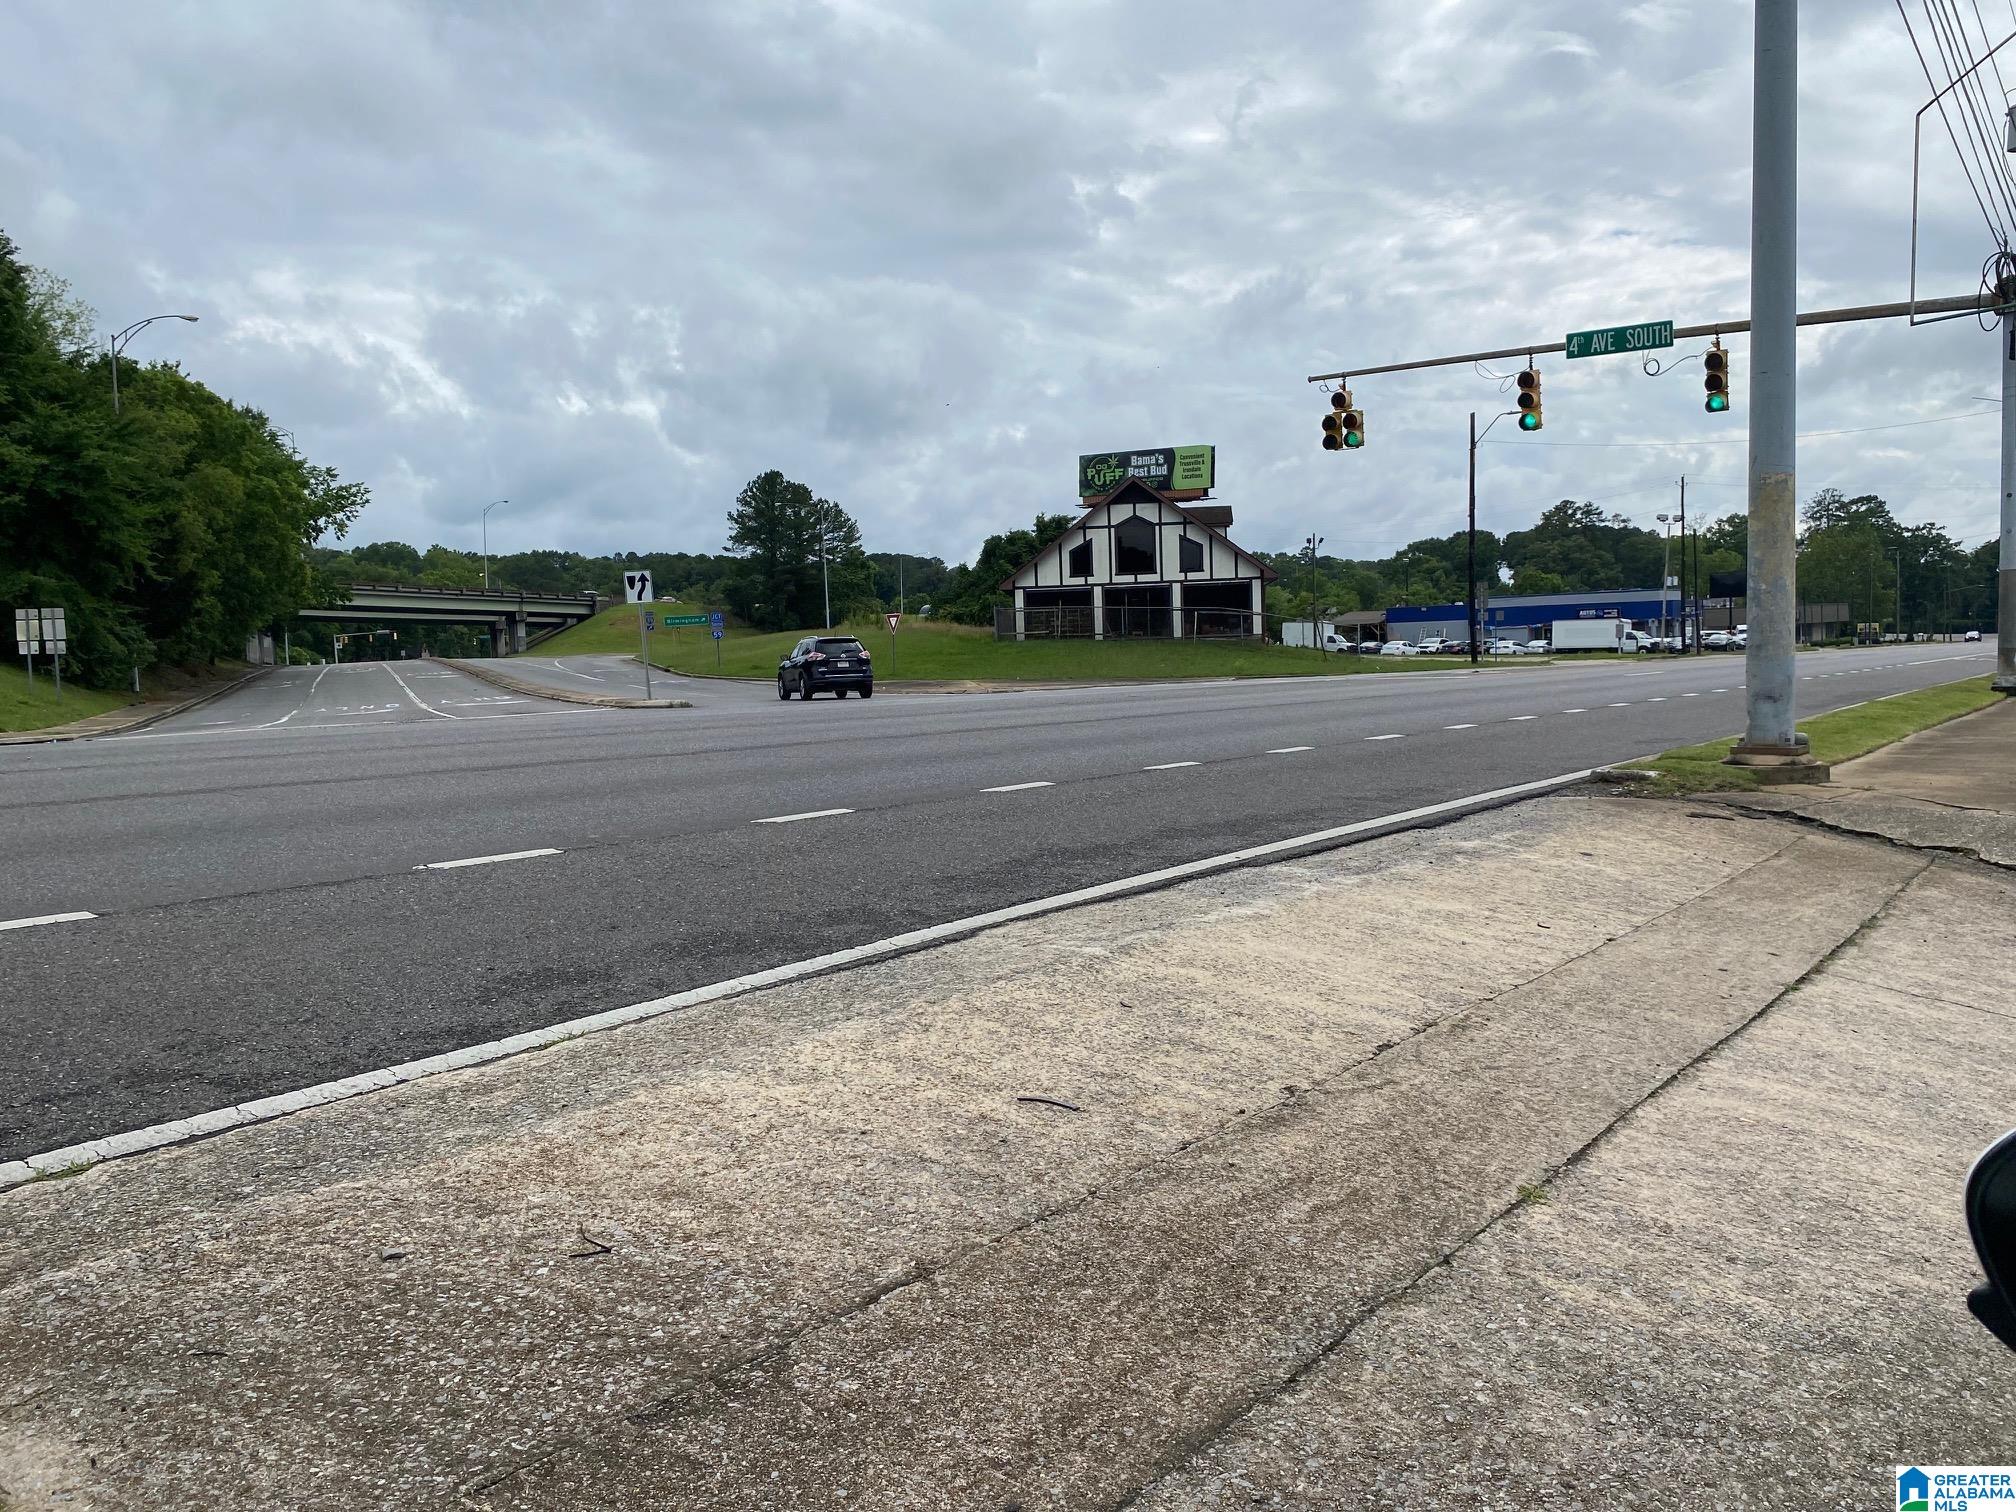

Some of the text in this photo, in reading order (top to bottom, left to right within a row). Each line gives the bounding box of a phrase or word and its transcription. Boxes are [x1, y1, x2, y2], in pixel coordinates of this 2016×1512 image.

[1569, 324, 1671, 355] 4th AVE SOUTH
[1131, 454, 1164, 466] Bama's
[1087, 468, 1123, 485] PUFF
[1128, 464, 1168, 478] Best Bud
